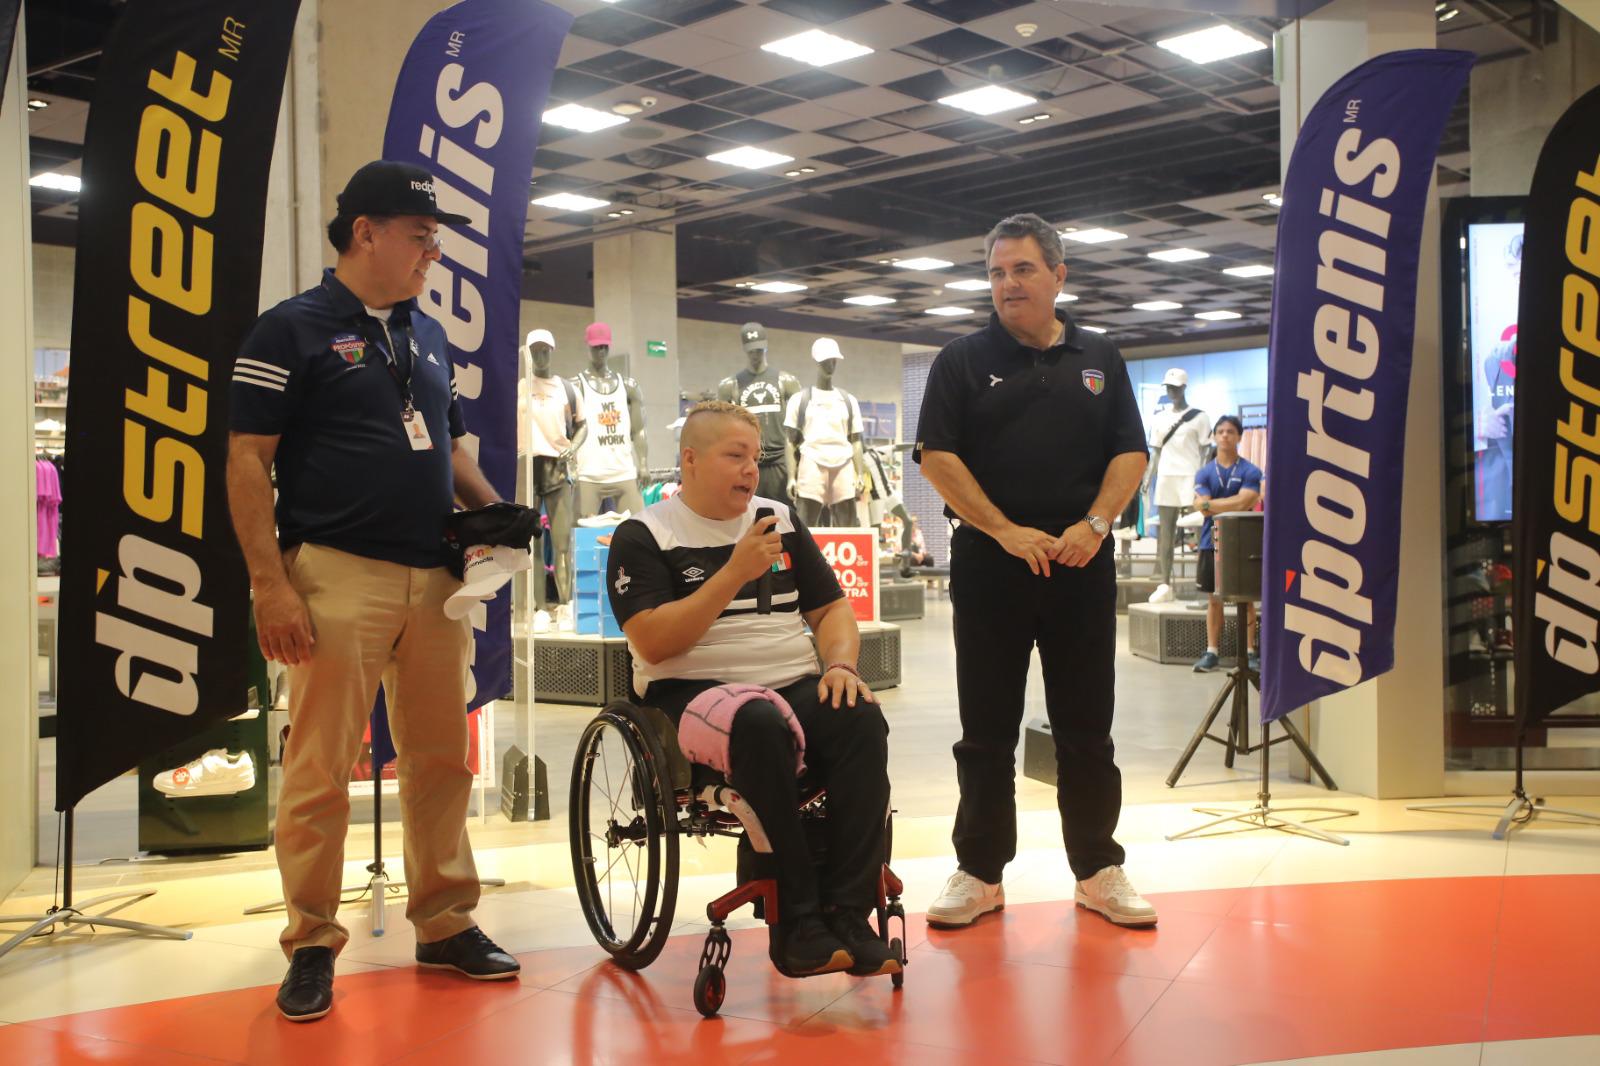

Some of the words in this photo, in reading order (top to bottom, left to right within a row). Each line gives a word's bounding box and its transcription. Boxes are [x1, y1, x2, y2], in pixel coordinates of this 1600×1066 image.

[218, 16, 246, 61] MR
[445, 31, 466, 57] MR
[1342, 99, 1362, 123] MR
[740, 381, 766, 407] PROJECT
[765, 383, 781, 405] ROCK
[1284, 128, 1401, 687] dportenis
[597, 434, 625, 446] WORK
[821, 541, 857, 567] 40
[842, 587, 869, 598] TRA
